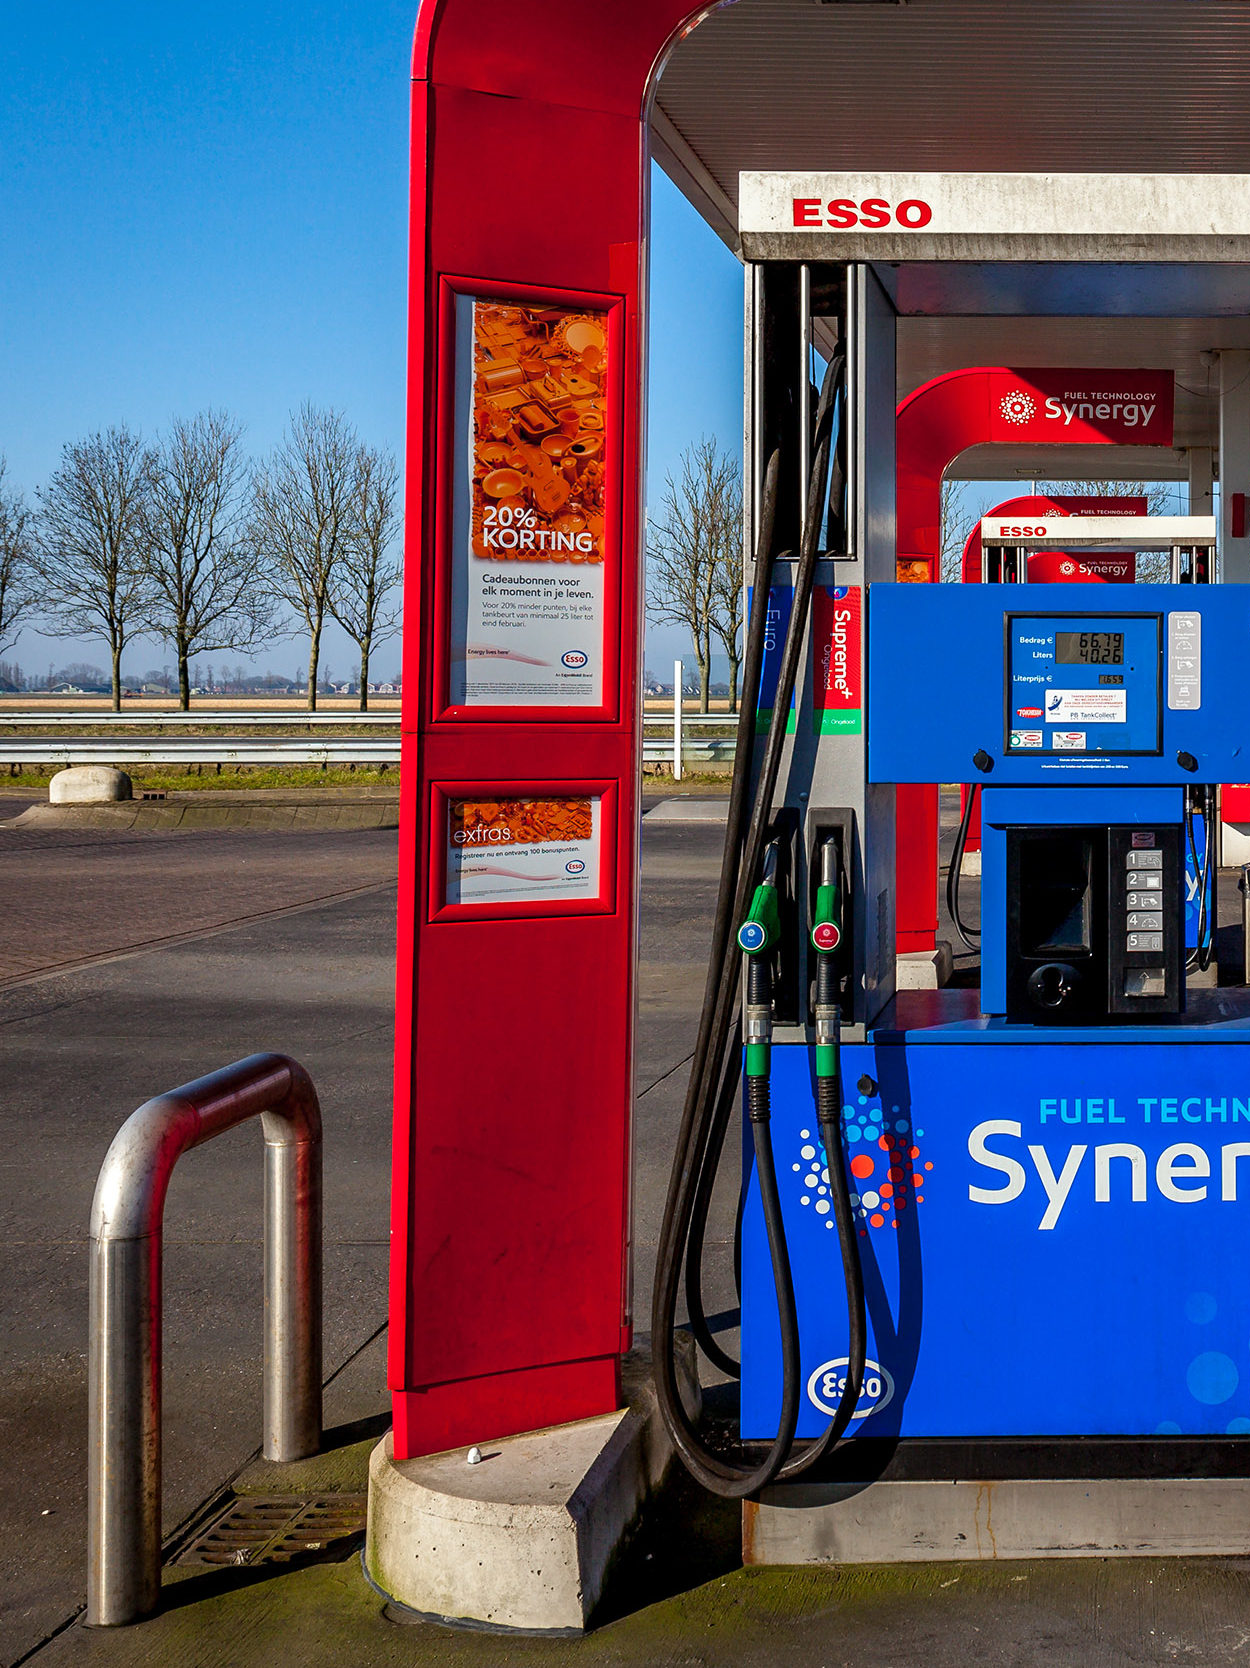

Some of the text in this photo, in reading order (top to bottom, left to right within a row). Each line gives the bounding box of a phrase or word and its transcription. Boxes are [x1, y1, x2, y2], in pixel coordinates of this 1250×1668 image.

[793, 198, 932, 228] ESSO
[1091, 392, 1156, 401] TECHNOLOGY
[1045, 397, 1156, 426] Synergy
[483, 506, 537, 528] 20%
[1000, 526, 1047, 537] ESSO
[483, 528, 593, 552] KORTING
[1079, 564, 1127, 576] Synergy
[482, 574, 556, 585] Cadeaubonnen
[482, 586, 594, 600] elk moment in je leven.
[764, 610, 780, 650] Euro
[1080, 633, 1121, 648] 66.79
[566, 655, 584, 663] Esso
[1080, 649, 1121, 663] 40.26
[821, 645, 833, 690] Ongelood
[454, 825, 510, 843] extras
[455, 852, 485, 860] Registreer
[542, 846, 579, 854] bonuspunten.
[1130, 853, 1136, 864] 1
[1129, 874, 1137, 884] 2
[1130, 894, 1137, 904] 3
[1129, 915, 1138, 925] 4
[1130, 935, 1137, 945] 5
[1040, 1098, 1126, 1124] FUEL
